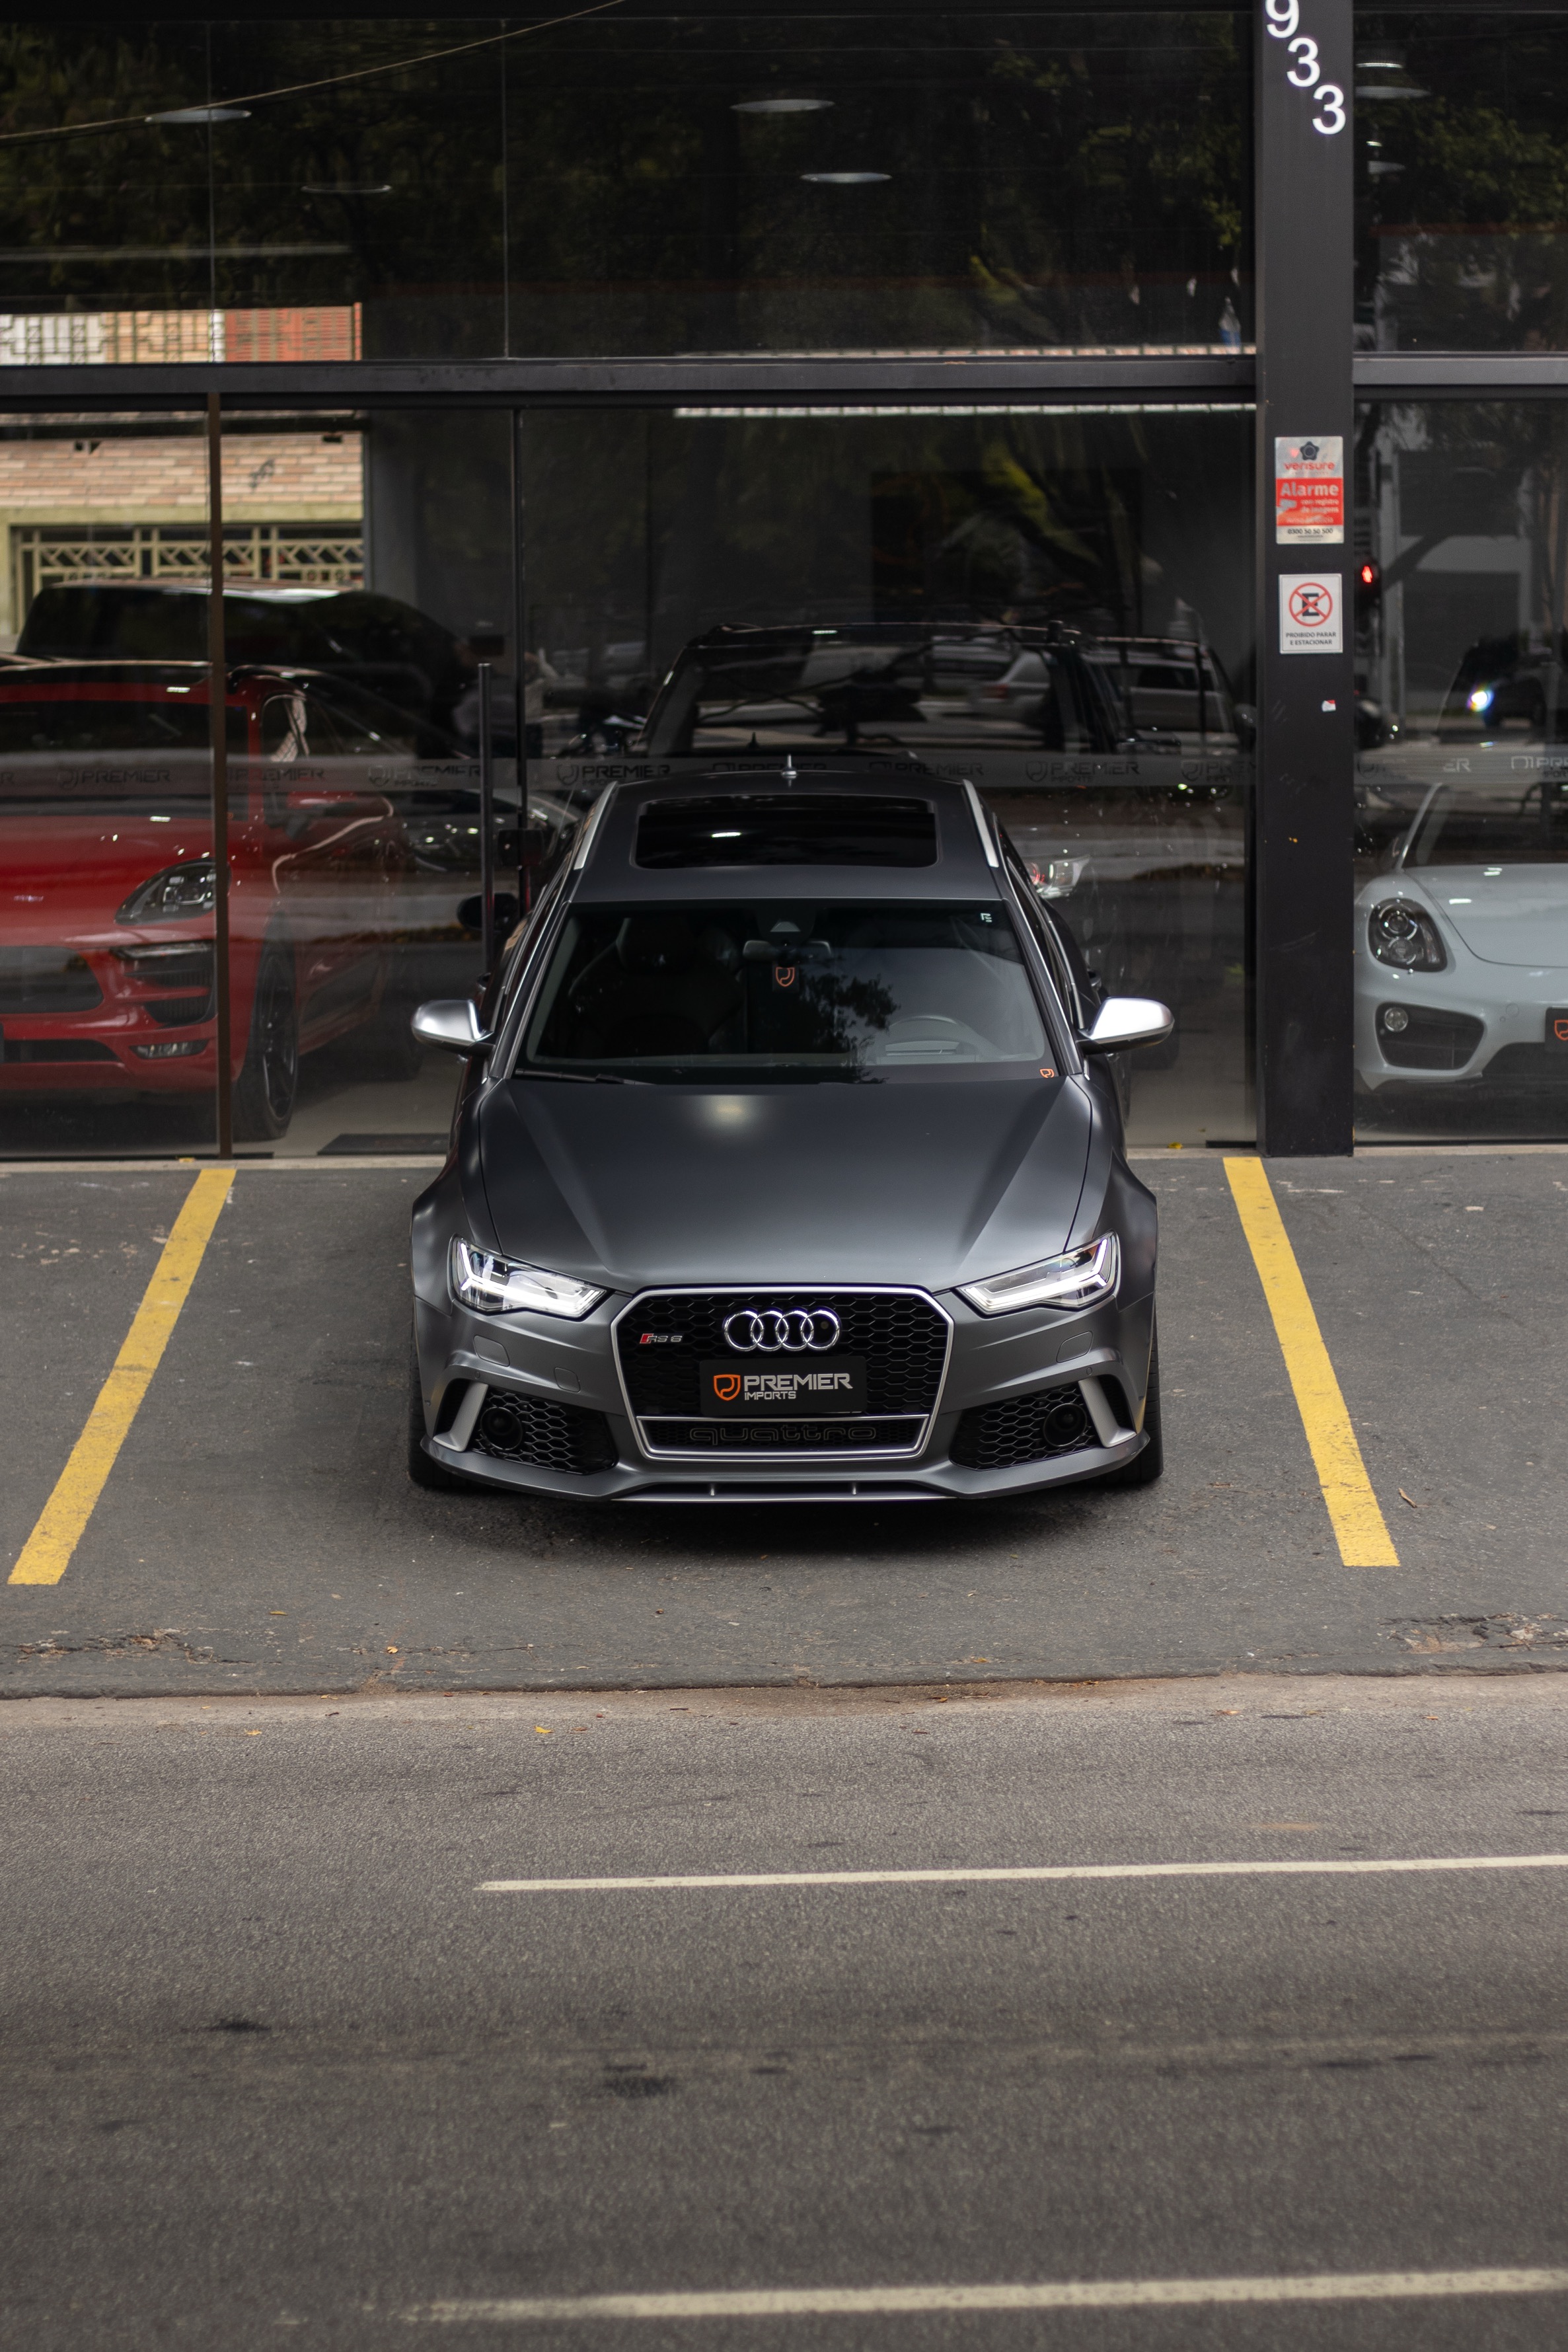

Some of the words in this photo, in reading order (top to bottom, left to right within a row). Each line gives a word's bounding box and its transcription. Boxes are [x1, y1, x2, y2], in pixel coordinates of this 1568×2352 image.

[1281, 481, 1339, 496] Alarme
[581, 764, 671, 778] PREMIER
[1050, 761, 1141, 775] PREMIER
[81, 769, 171, 783] PREMIER
[743, 1373, 853, 1392] PREMIER
[744, 1390, 796, 1400] IMPORTS
[689, 1424, 877, 1446] quattro
